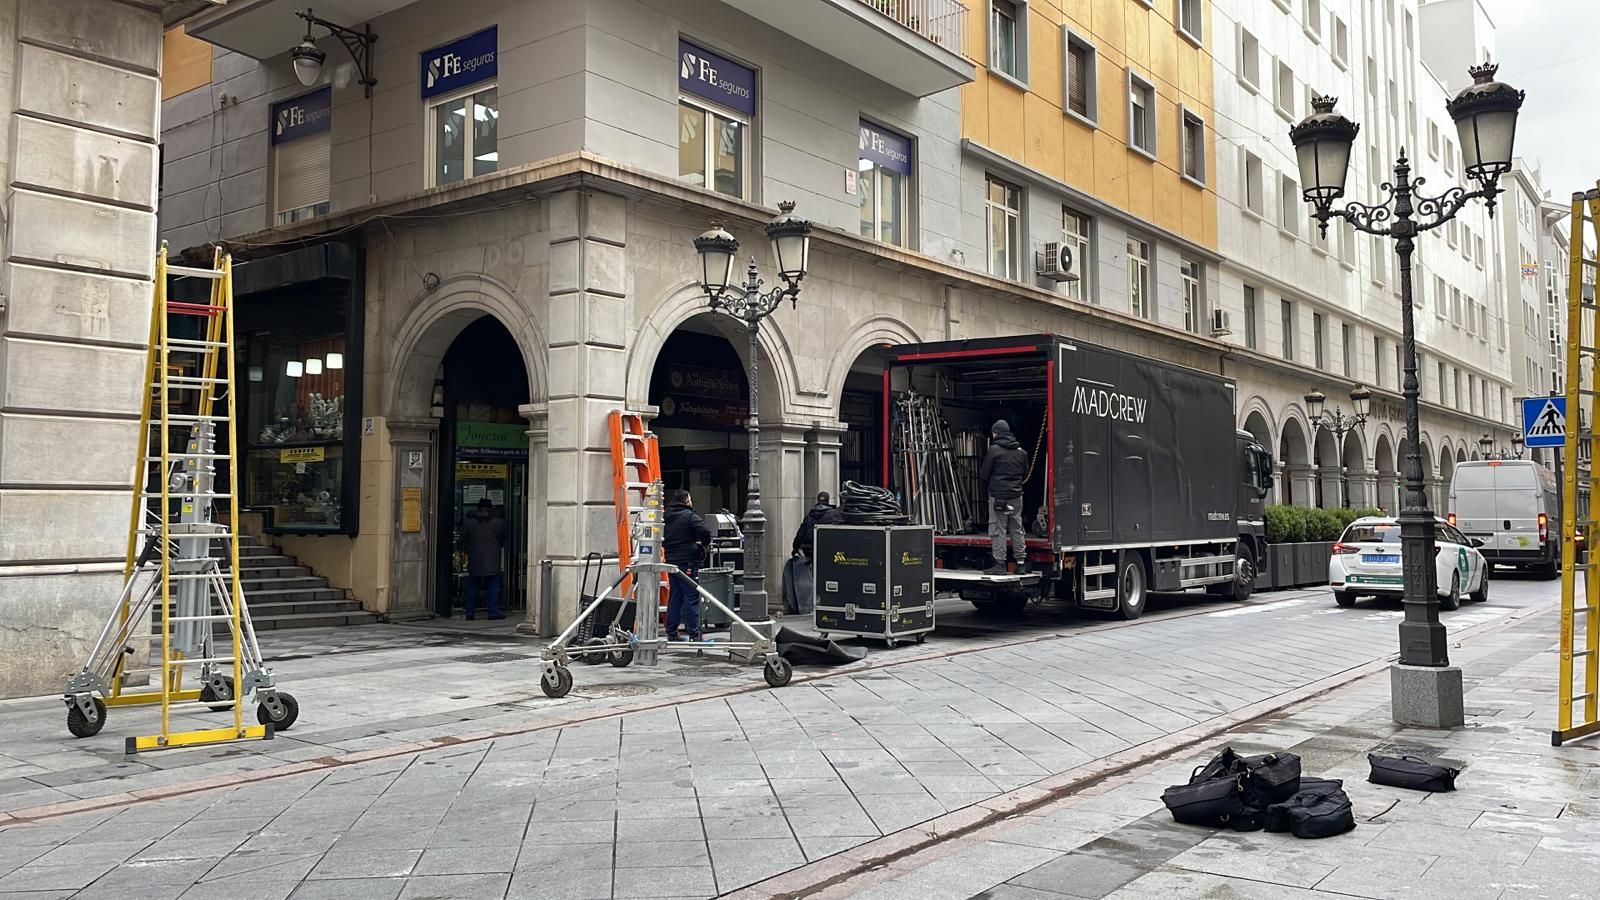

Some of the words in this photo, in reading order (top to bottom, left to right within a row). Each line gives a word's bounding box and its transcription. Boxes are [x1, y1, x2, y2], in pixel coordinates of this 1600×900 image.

[442, 53, 462, 78] FE
[462, 51, 495, 73] seguros
[698, 57, 718, 87] FE
[718, 78, 750, 99] seguros
[289, 106, 305, 128] FE
[304, 106, 331, 123] seguros
[871, 131, 885, 154] FE
[884, 147, 908, 163] seguros
[1072, 385, 1147, 423] MADCREW
[1207, 510, 1230, 521] madcrew.es
